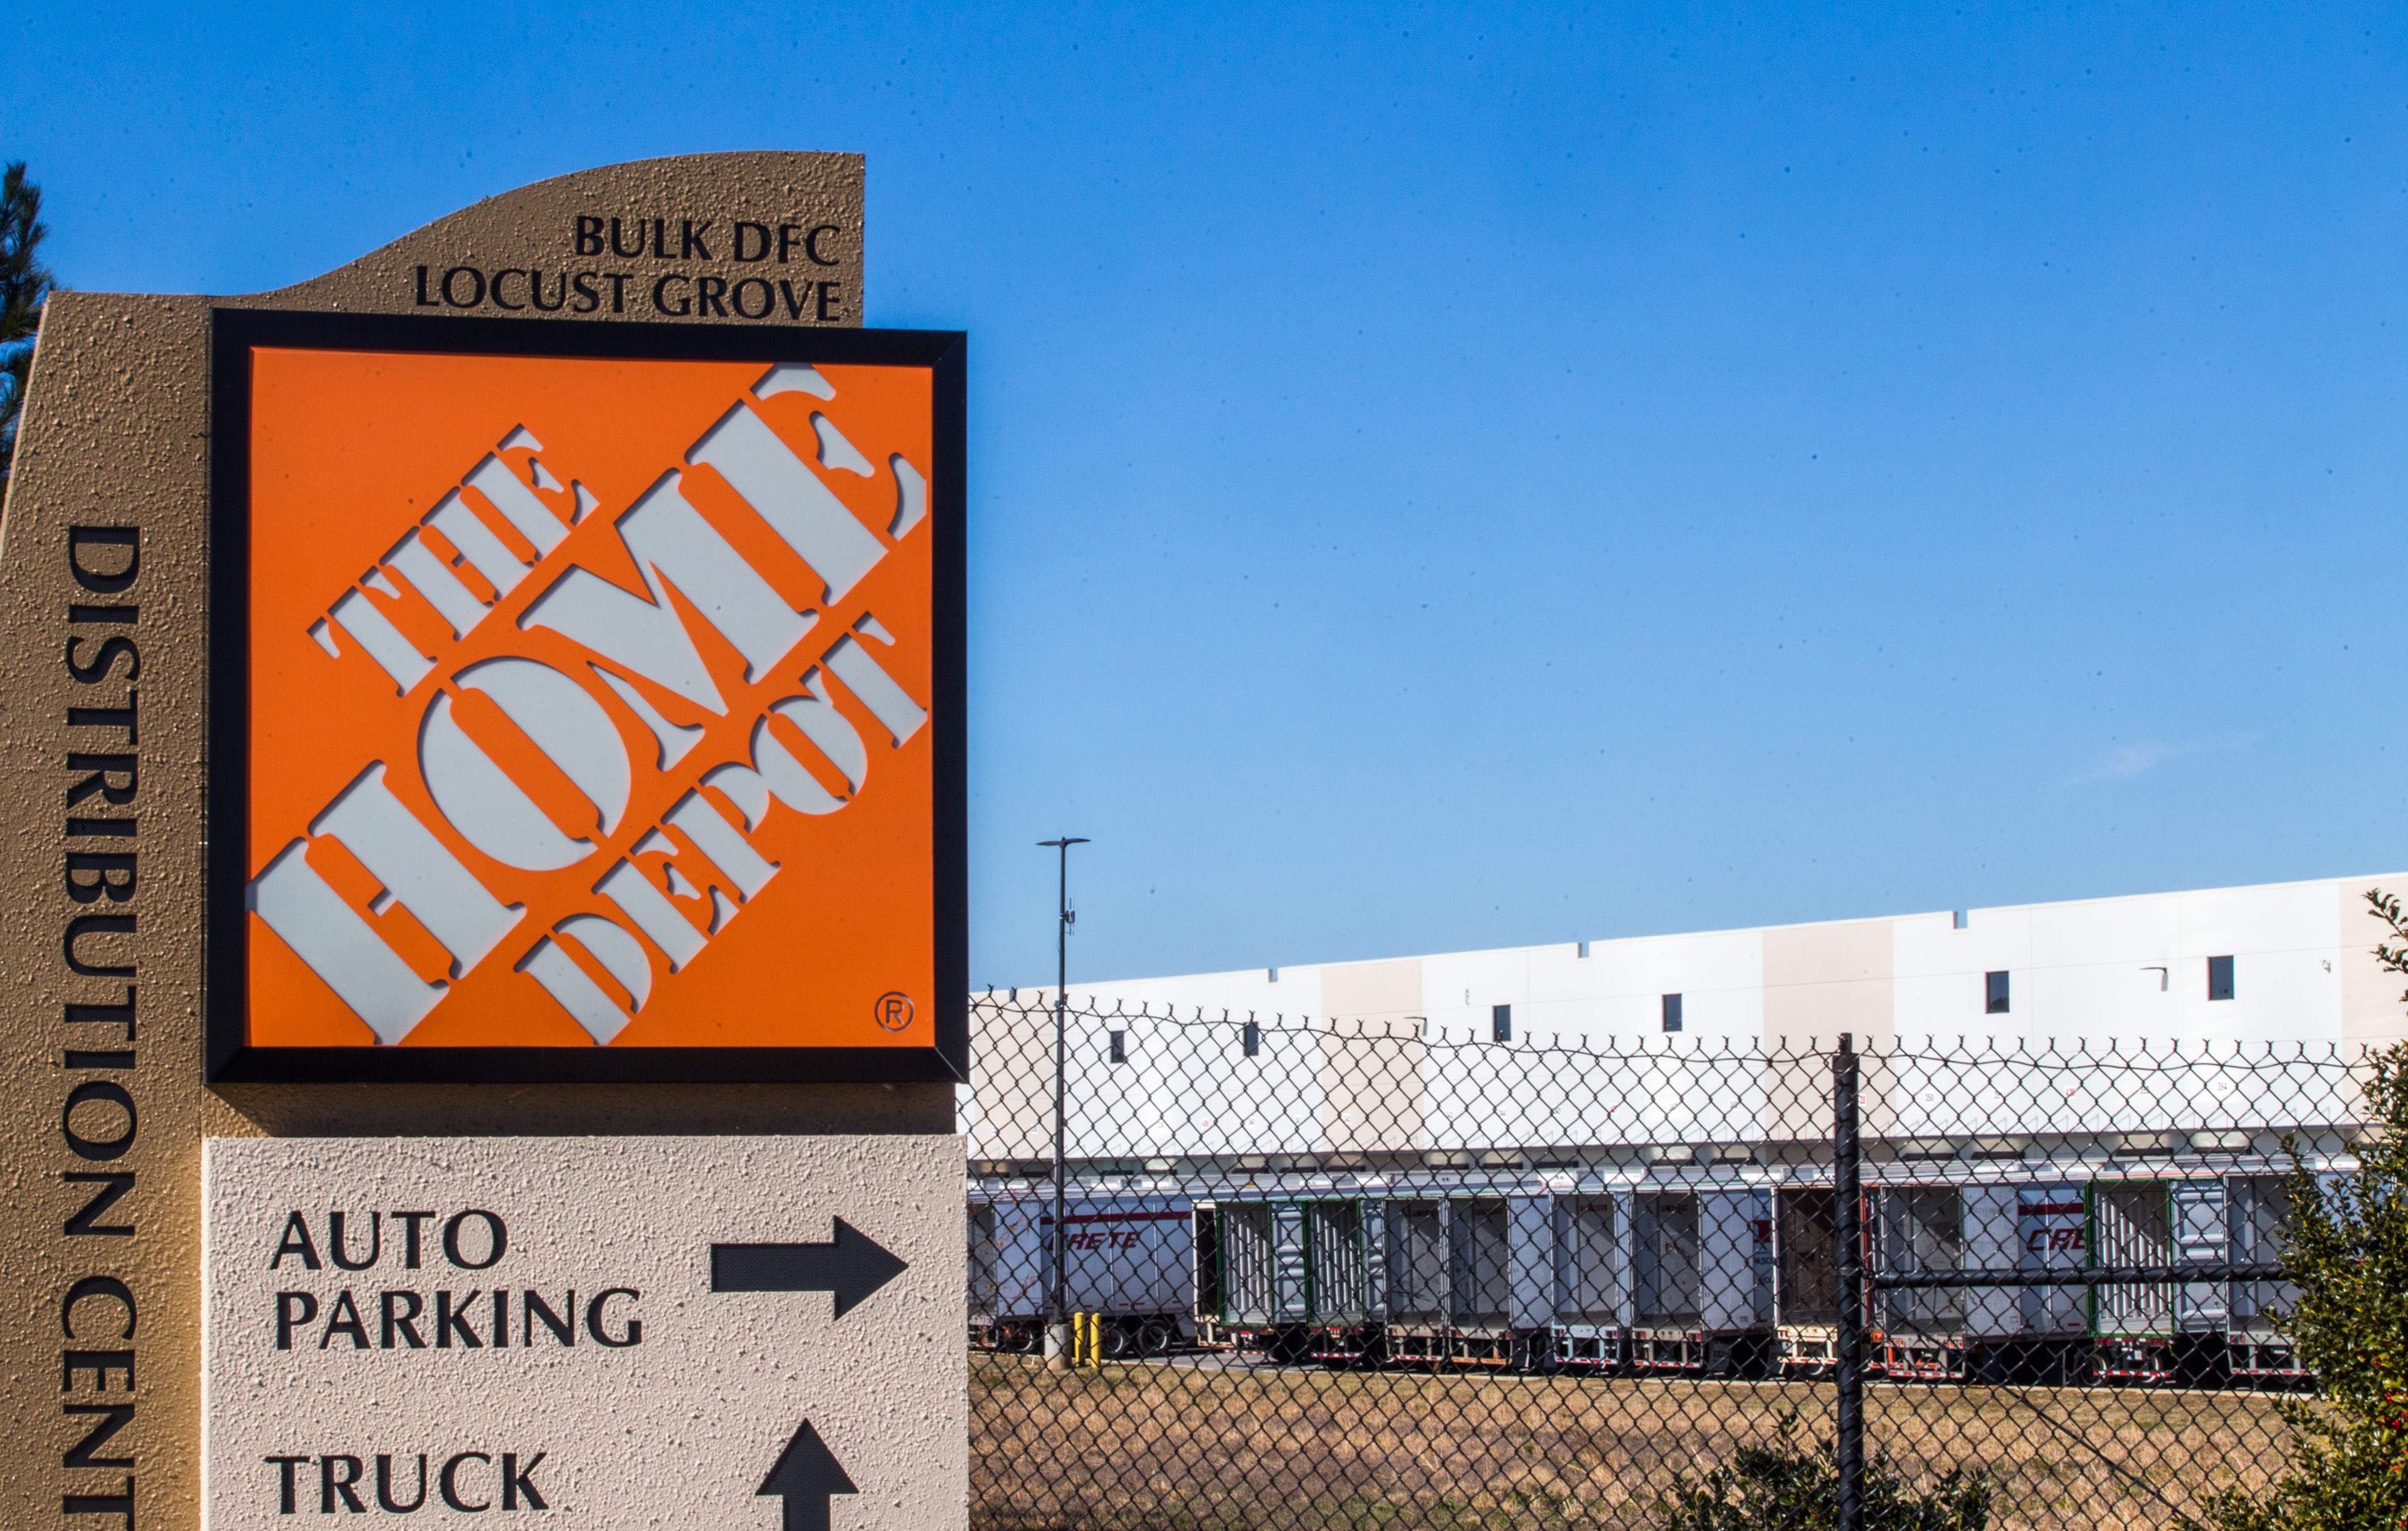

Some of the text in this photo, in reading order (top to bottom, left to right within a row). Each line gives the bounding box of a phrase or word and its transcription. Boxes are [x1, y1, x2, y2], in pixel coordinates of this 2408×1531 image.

[576, 215, 841, 266] BULK DFC
[415, 265, 841, 322] LOCUST GROVE
[305, 423, 600, 698] THE
[245, 362, 927, 1045] HOME
[512, 610, 927, 1046] DEPOT
[63, 525, 140, 1237] DISTRIBUTION
[270, 1209, 508, 1271] AUTO
[275, 1286, 643, 1350] PARKING
[263, 1451, 549, 1514] TRUCK
